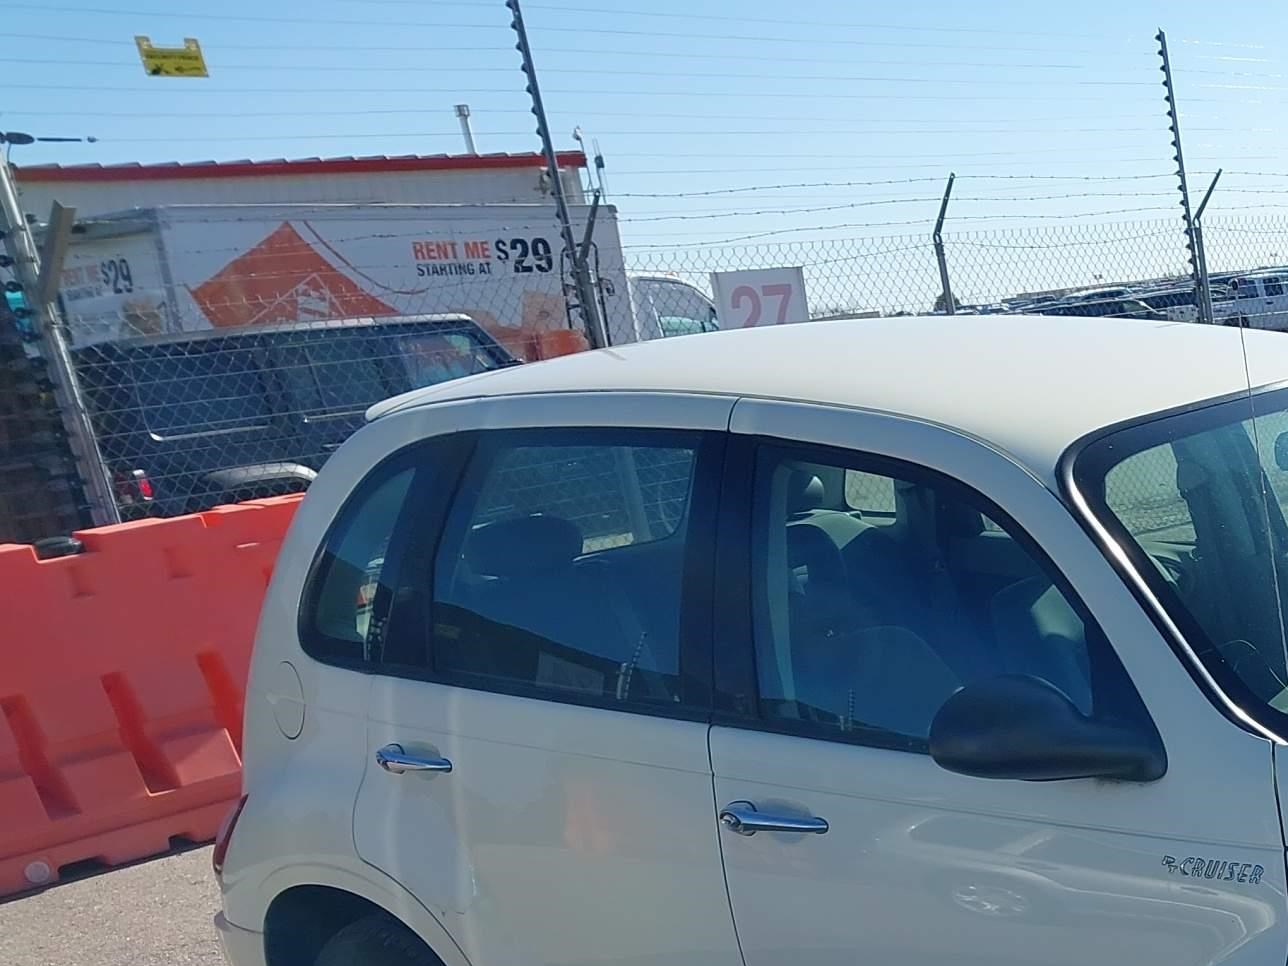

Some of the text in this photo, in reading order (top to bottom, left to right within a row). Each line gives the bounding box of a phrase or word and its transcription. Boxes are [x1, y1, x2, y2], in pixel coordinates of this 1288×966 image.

[412, 238, 553, 273] RENT ME $29
[416, 261, 492, 277] STARTING AT
[101, 259, 133, 294] $29
[731, 284, 793, 328] 27
[1180, 857, 1264, 884] CRUISER
